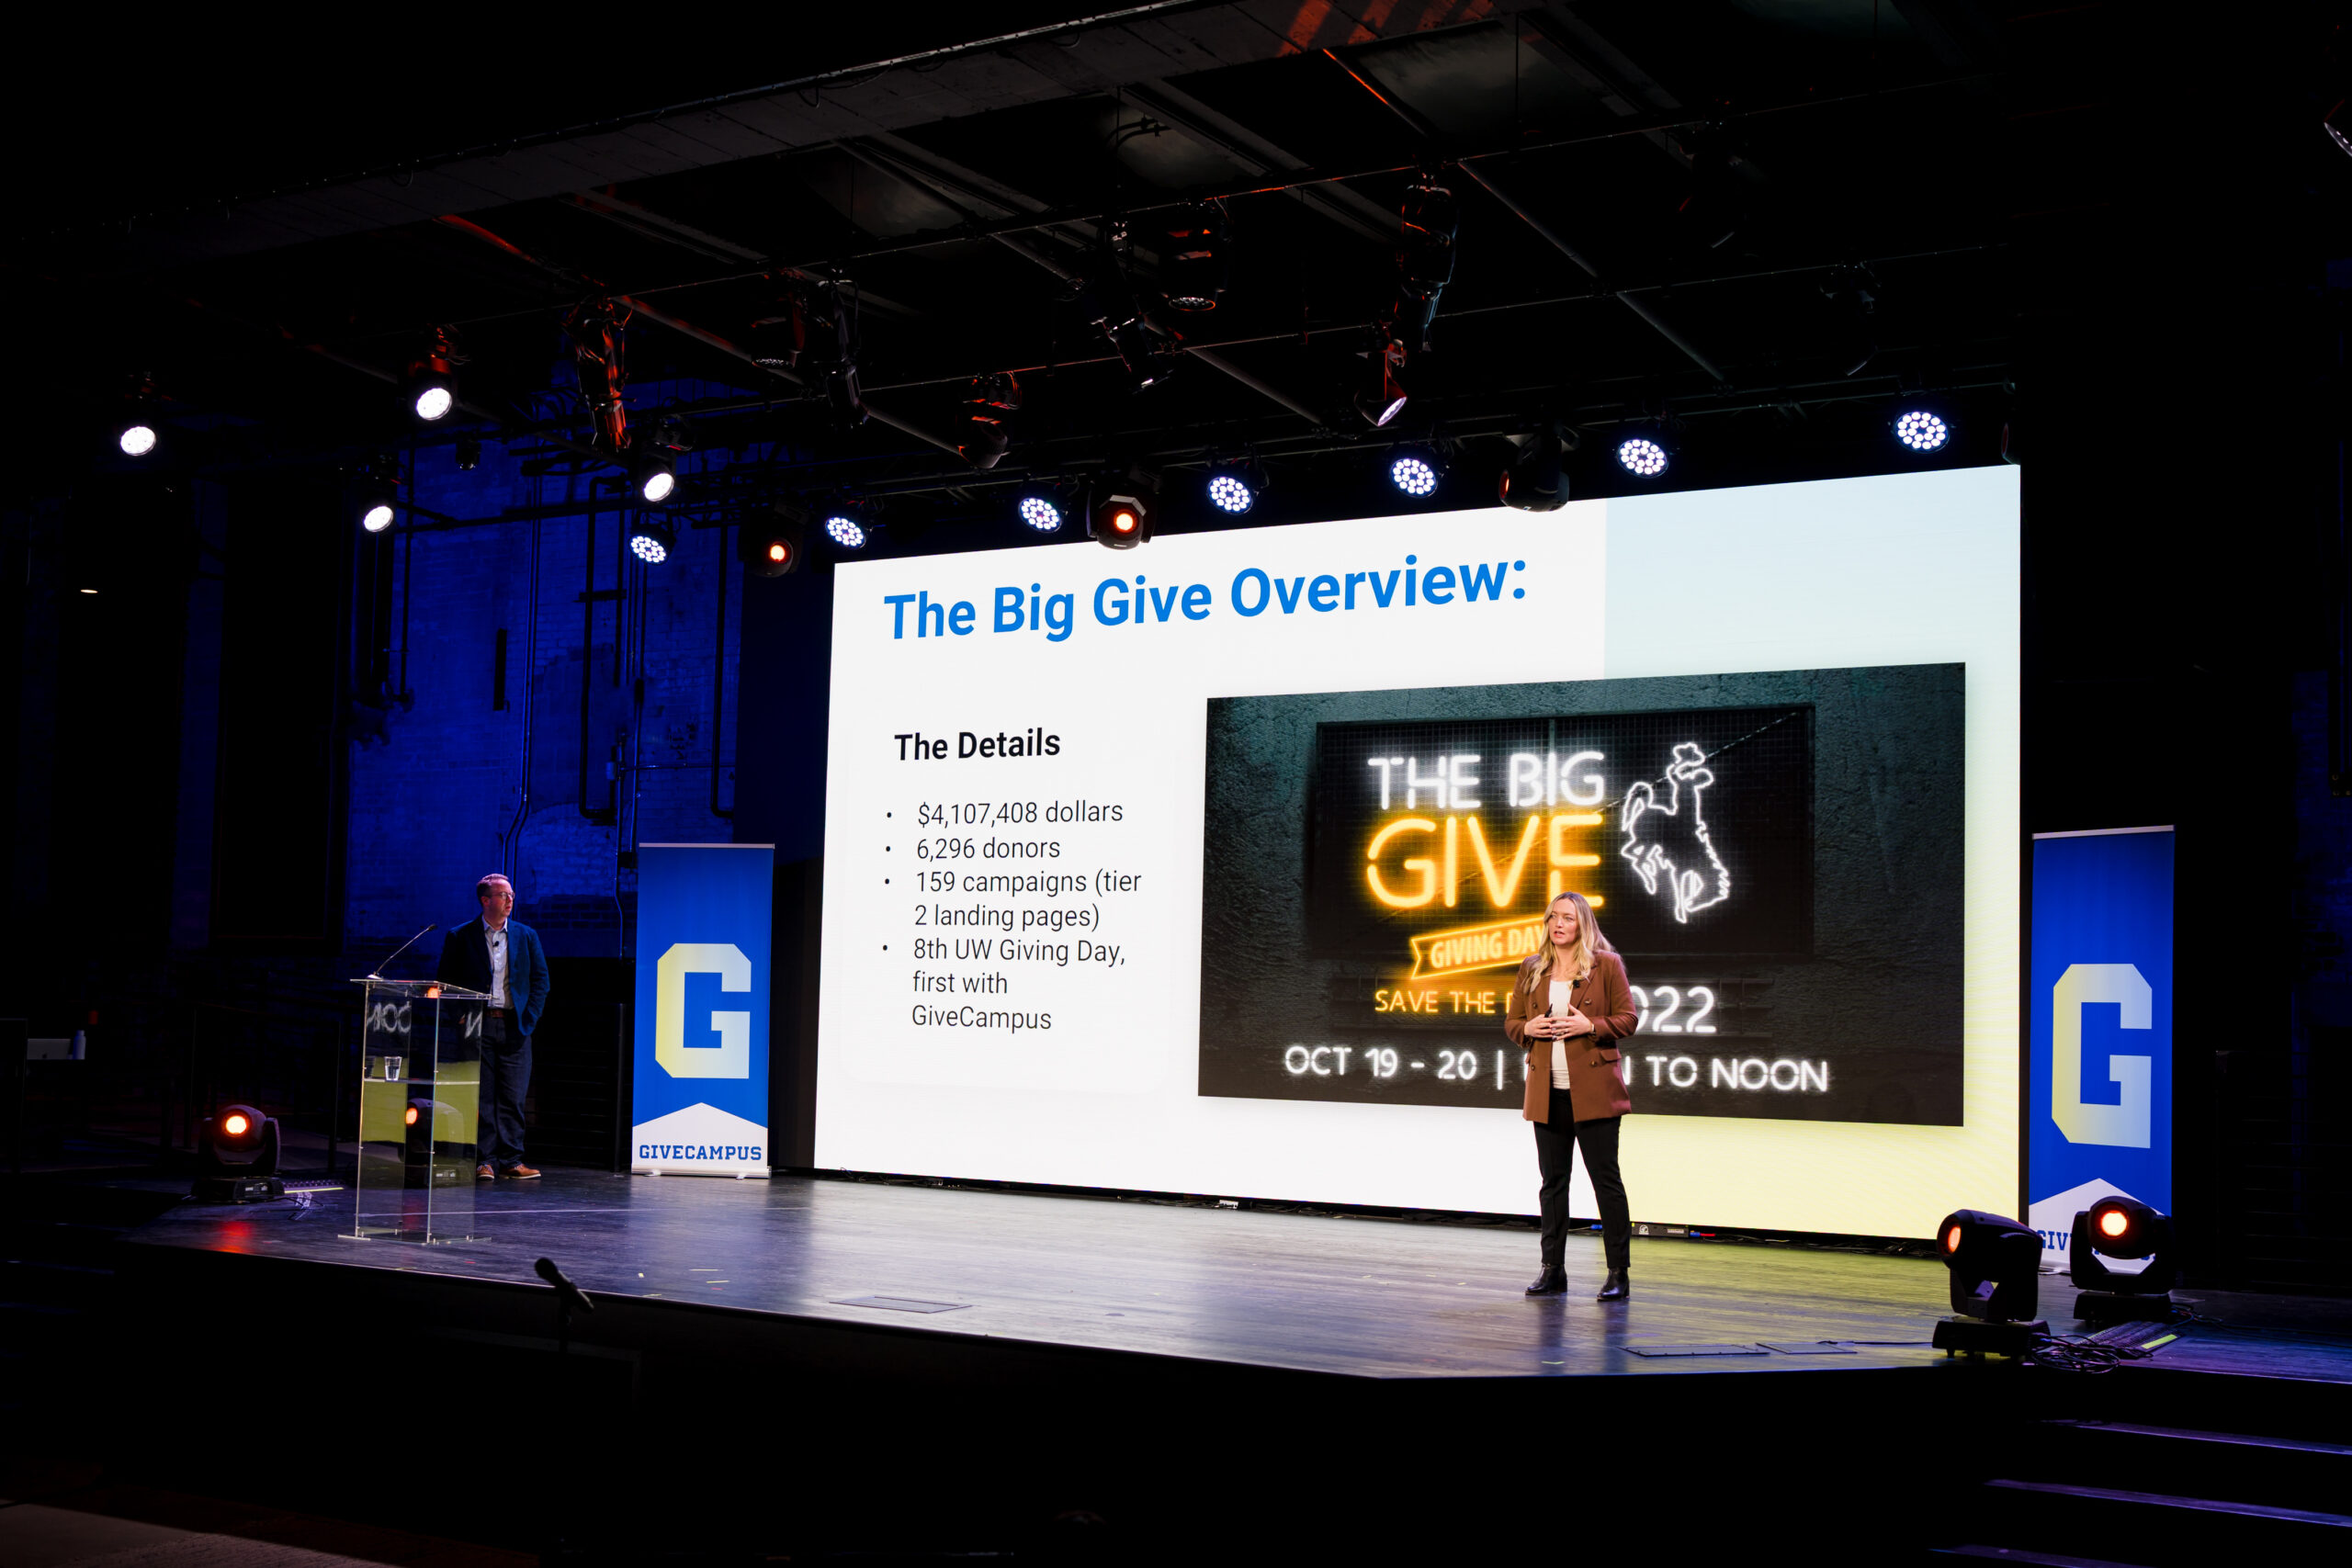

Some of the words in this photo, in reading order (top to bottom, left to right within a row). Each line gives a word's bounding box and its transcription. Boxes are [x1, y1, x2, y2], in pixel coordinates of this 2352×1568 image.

[884, 591, 976, 640] The
[993, 582, 1074, 643] Big
[1093, 575, 1212, 626] Give
[1230, 554, 1526, 617] Overview:
[894, 732, 948, 761] The
[957, 728, 1060, 759] Details
[1367, 753, 1482, 811] THE
[1509, 750, 1605, 807] BIG
[918, 801, 1038, 829] $4,107,408
[1046, 799, 1124, 823] dollars
[917, 838, 976, 863] 6,296
[982, 836, 1060, 859] donors
[1366, 813, 1605, 909] GIVE
[916, 871, 956, 893] 159
[963, 871, 1087, 898] campaigns
[1095, 867, 1142, 897] (tier
[914, 904, 927, 926] 2
[934, 903, 1014, 932] landing
[1022, 903, 1100, 933] pages)
[913, 937, 947, 960] 8th
[956, 938, 993, 960] UW
[1000, 939, 1069, 967] Giving
[1078, 940, 1125, 968] Day,
[1430, 931, 1503, 969] GIVING
[912, 969, 956, 993] first
[962, 971, 1008, 994] with
[655, 942, 752, 1079] G
[1374, 989, 1439, 1014] SAVE
[1449, 990, 1496, 1014] THE
[911, 1004, 1052, 1034] GiveCampus
[1284, 1044, 1352, 1076] OCT
[1364, 1047, 1398, 1077] 19
[1437, 1050, 1477, 1080] 20
[2052, 963, 2153, 1149] G
[1645, 1055, 1698, 1088] TO
[1712, 1057, 1828, 1092] NOON
[639, 1145, 762, 1161] GIVECAMPUS
